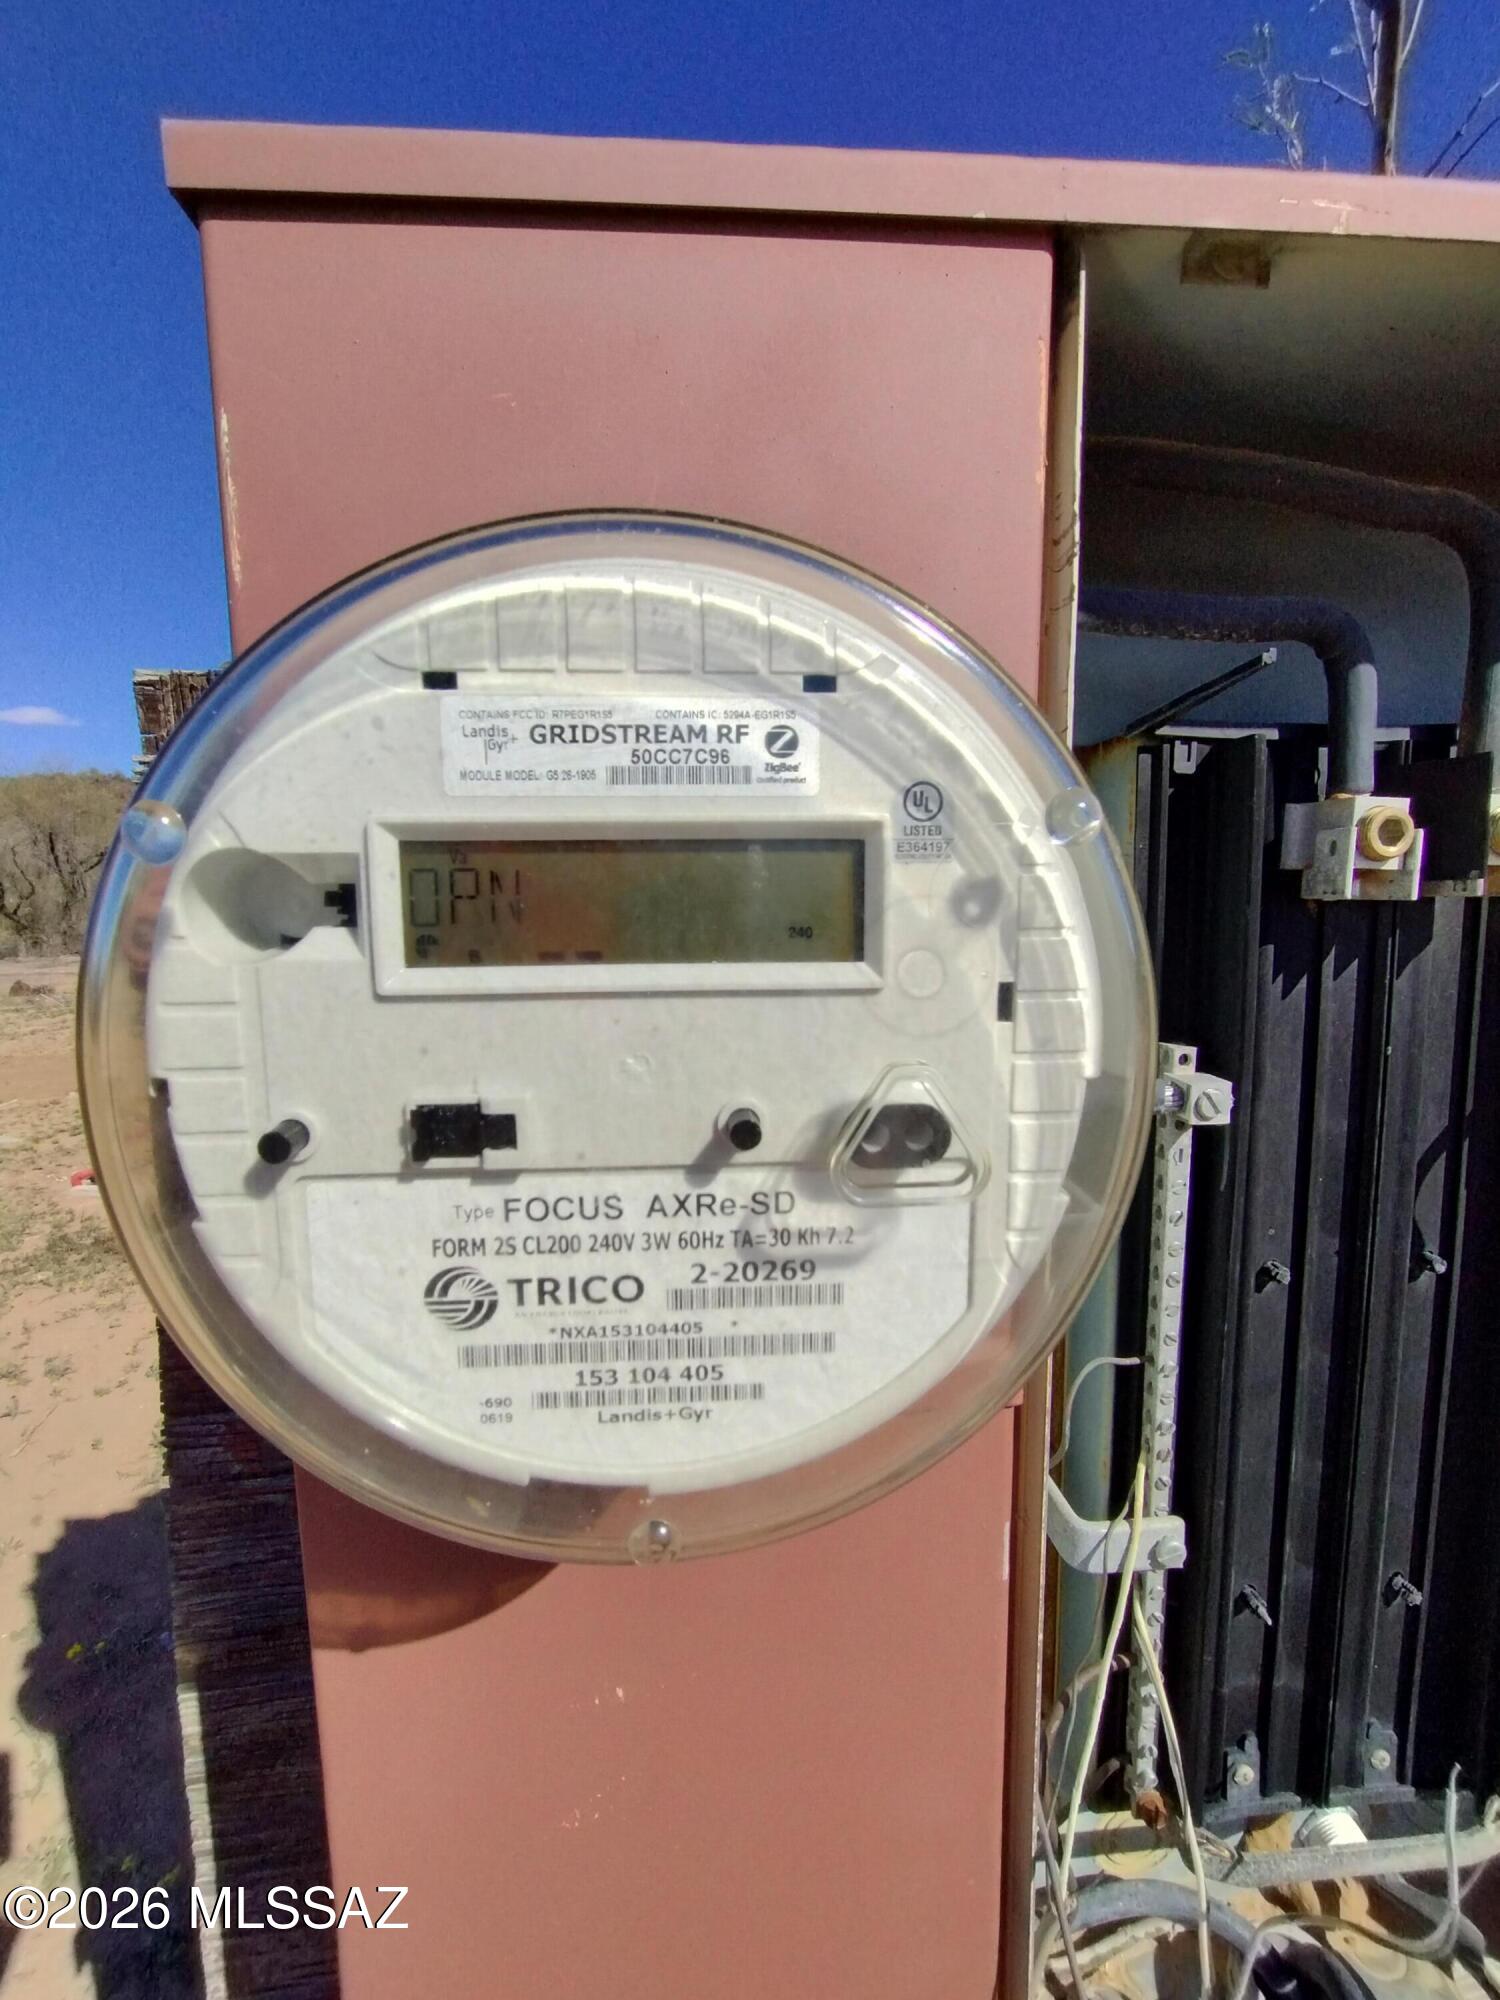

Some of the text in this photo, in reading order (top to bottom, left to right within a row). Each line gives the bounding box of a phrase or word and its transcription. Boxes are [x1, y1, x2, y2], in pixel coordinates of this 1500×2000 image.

[459, 709, 510, 720] CONTAINS
[513, 709, 532, 719] FCC
[655, 709, 705, 720] CONTAINS
[708, 709, 721, 720] IC:
[462, 724, 509, 738] Landis
[529, 723, 750, 744] GRIDSTREAM RF
[630, 748, 730, 765] 50CC7C96
[459, 770, 501, 781] MODULE
[903, 825, 942, 836] LISTED
[897, 841, 950, 853] E364197
[788, 926, 813, 939] 240
[453, 1190, 796, 1223] Type FOCUS AXRe-SD
[431, 1226, 854, 1258] FORM 2S CL200 240V 3W 60Hz TA=30 Kh 7.2
[690, 1258, 817, 1285] 2-20269
[506, 1274, 645, 1307] TRICO
[575, 1364, 724, 1387] 153 104 405
[480, 1412, 513, 1424] 0619
[597, 1406, 714, 1424] Landis+Gyr
